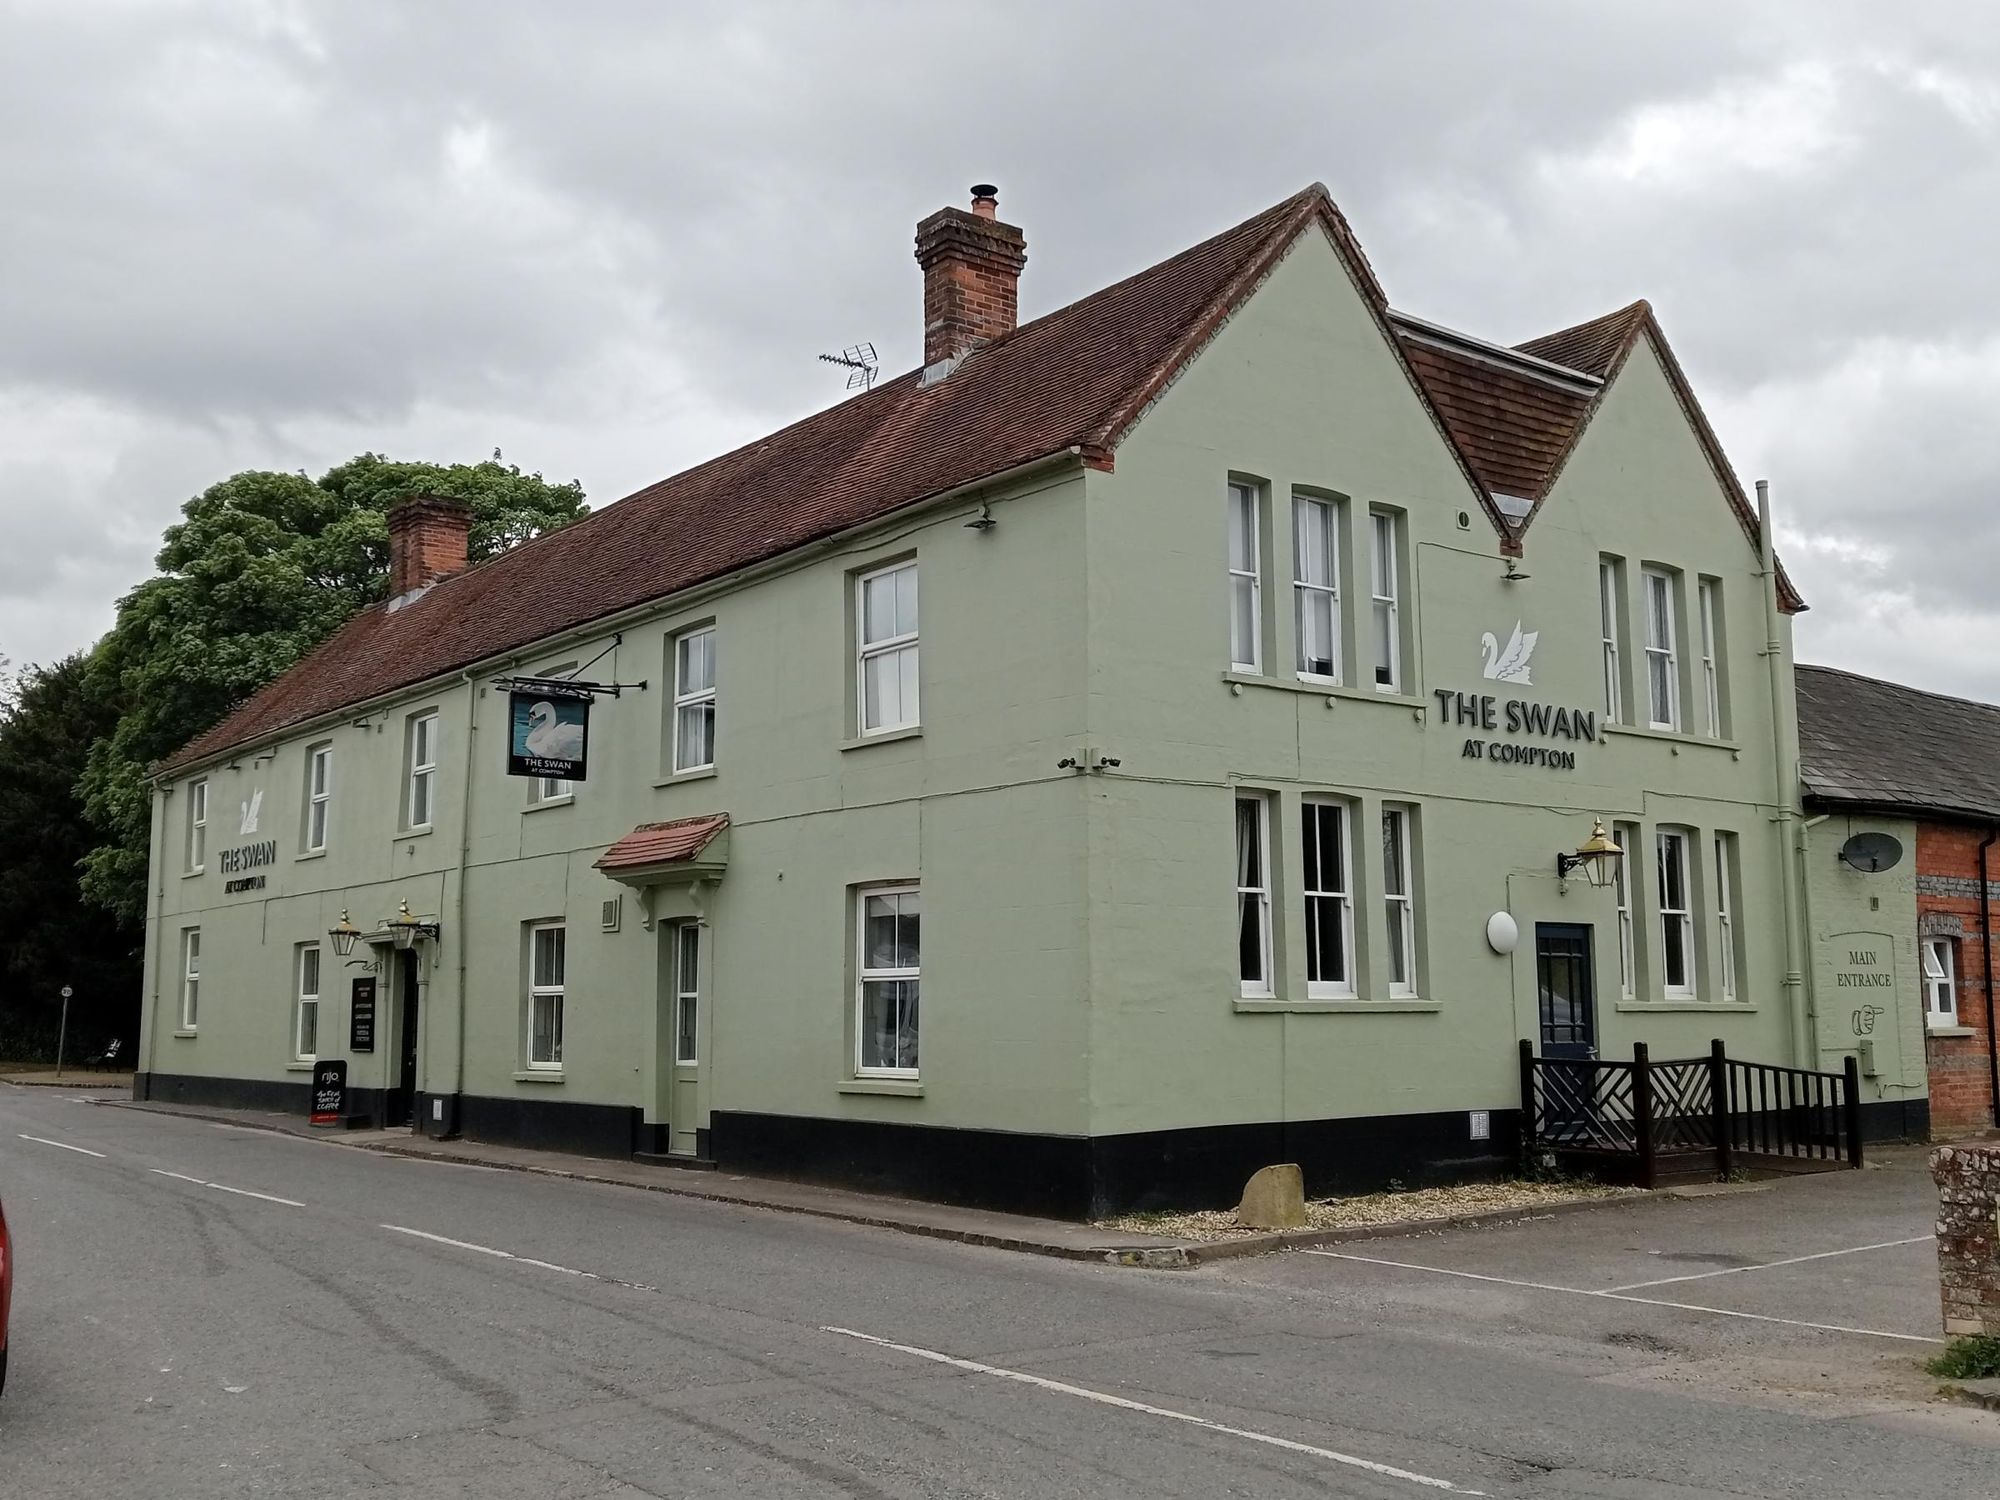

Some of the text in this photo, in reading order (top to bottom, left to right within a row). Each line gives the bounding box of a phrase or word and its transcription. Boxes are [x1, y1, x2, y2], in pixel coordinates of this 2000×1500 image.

[1434, 689, 1595, 741] THE SWAN
[524, 758, 571, 769] THE SWAN
[1462, 738, 1576, 770] AT COMPTON
[218, 840, 276, 874] THE SWAN
[1849, 951, 1877, 965] MAIN
[1837, 973, 1892, 987] ENTRANCE
